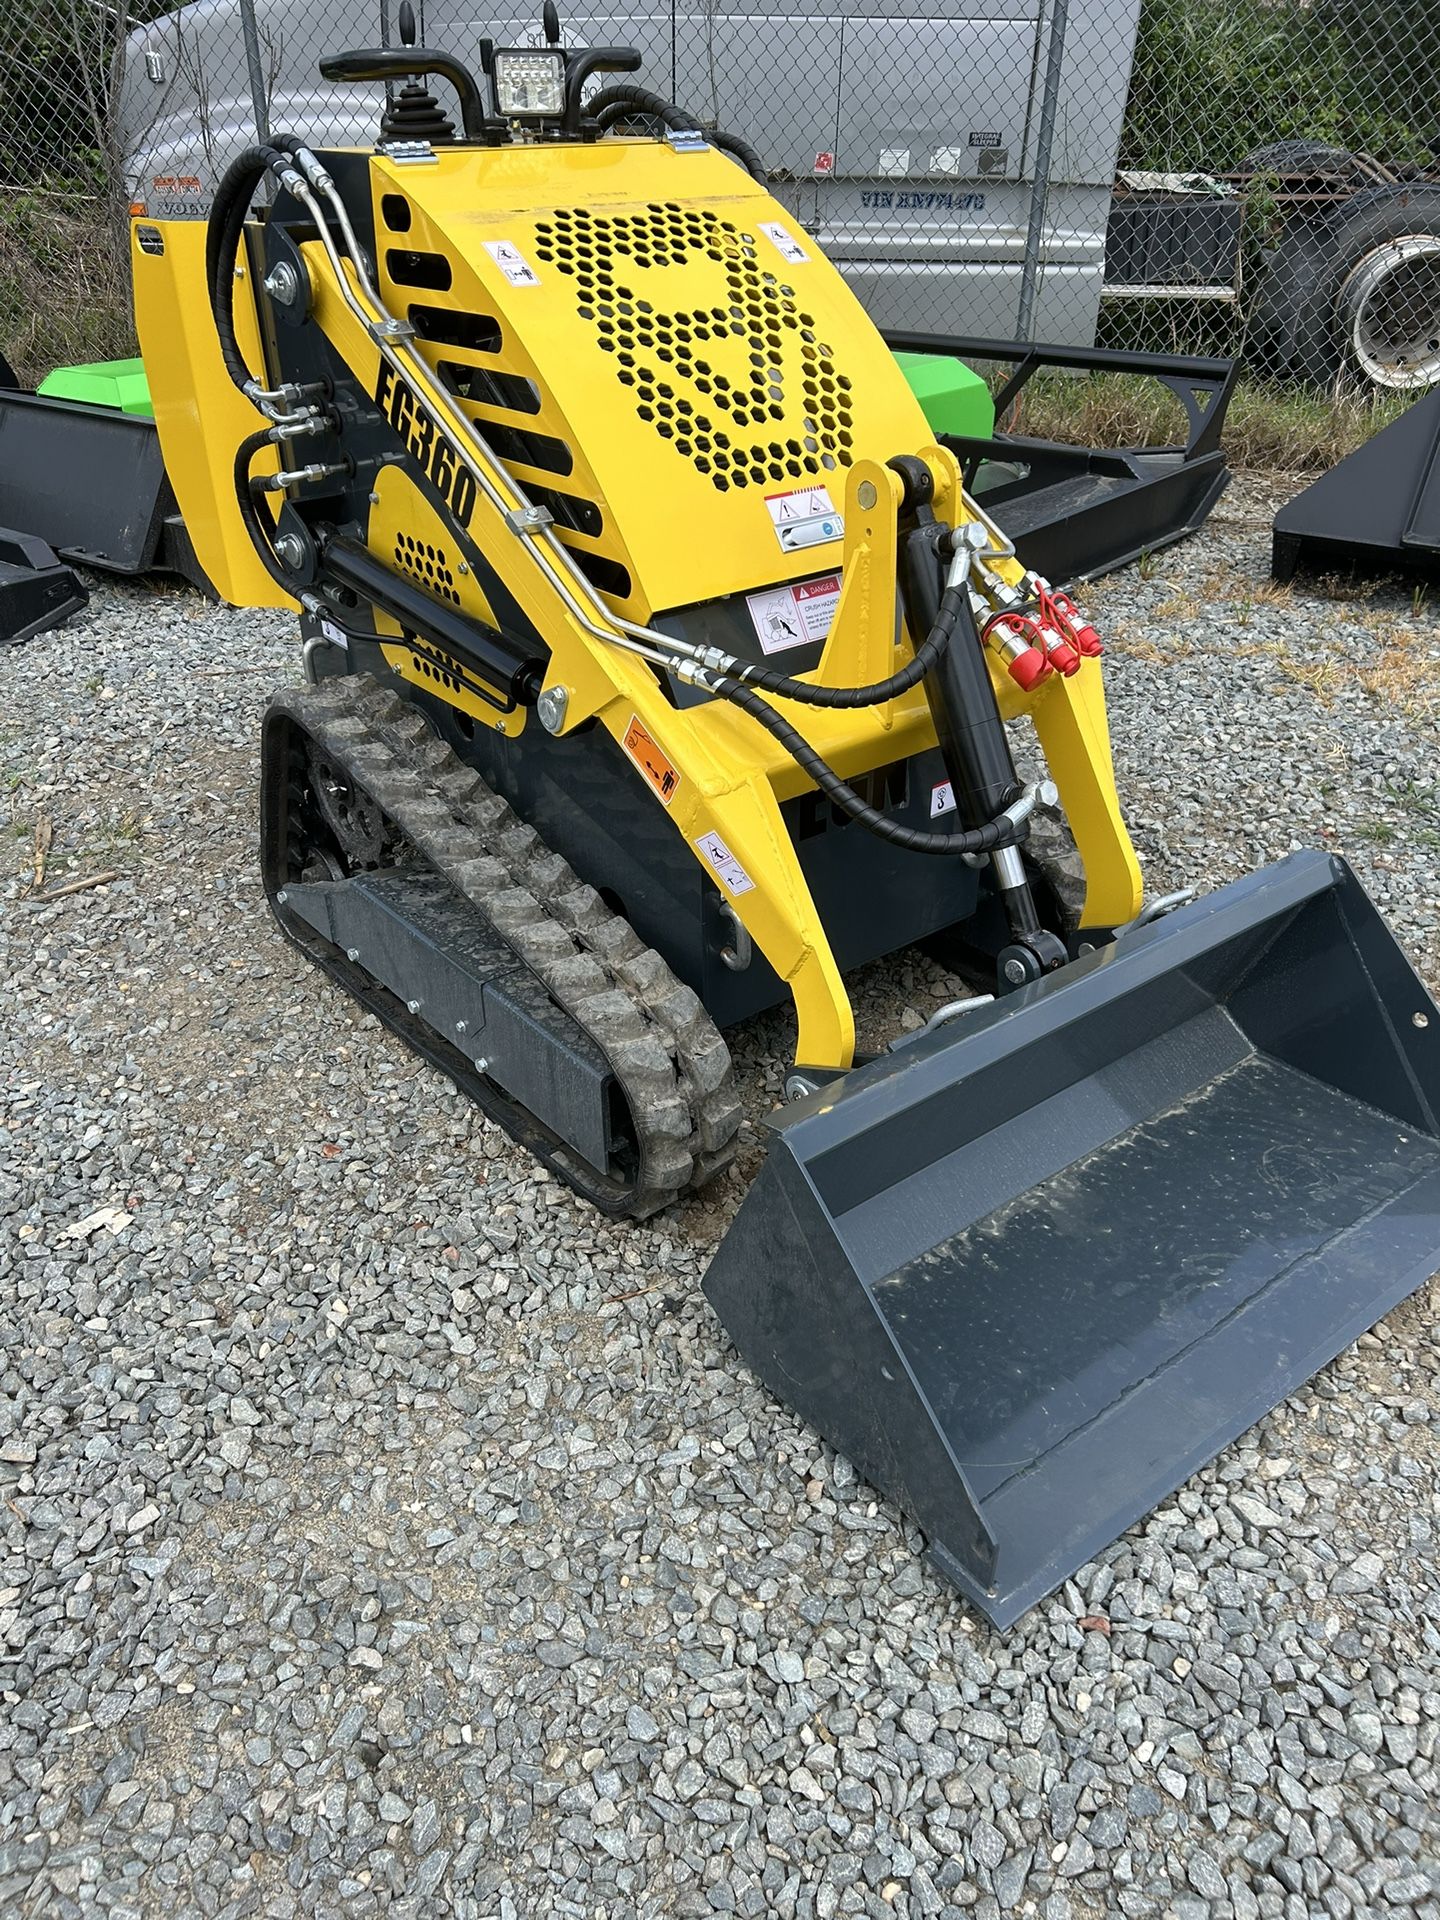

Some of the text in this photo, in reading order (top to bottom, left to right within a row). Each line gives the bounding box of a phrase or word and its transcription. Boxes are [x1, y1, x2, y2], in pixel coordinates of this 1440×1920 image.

[158, 202, 212, 215] VOLV
[375, 353, 477, 529] EG360
[810, 582, 835, 594] DANGER
